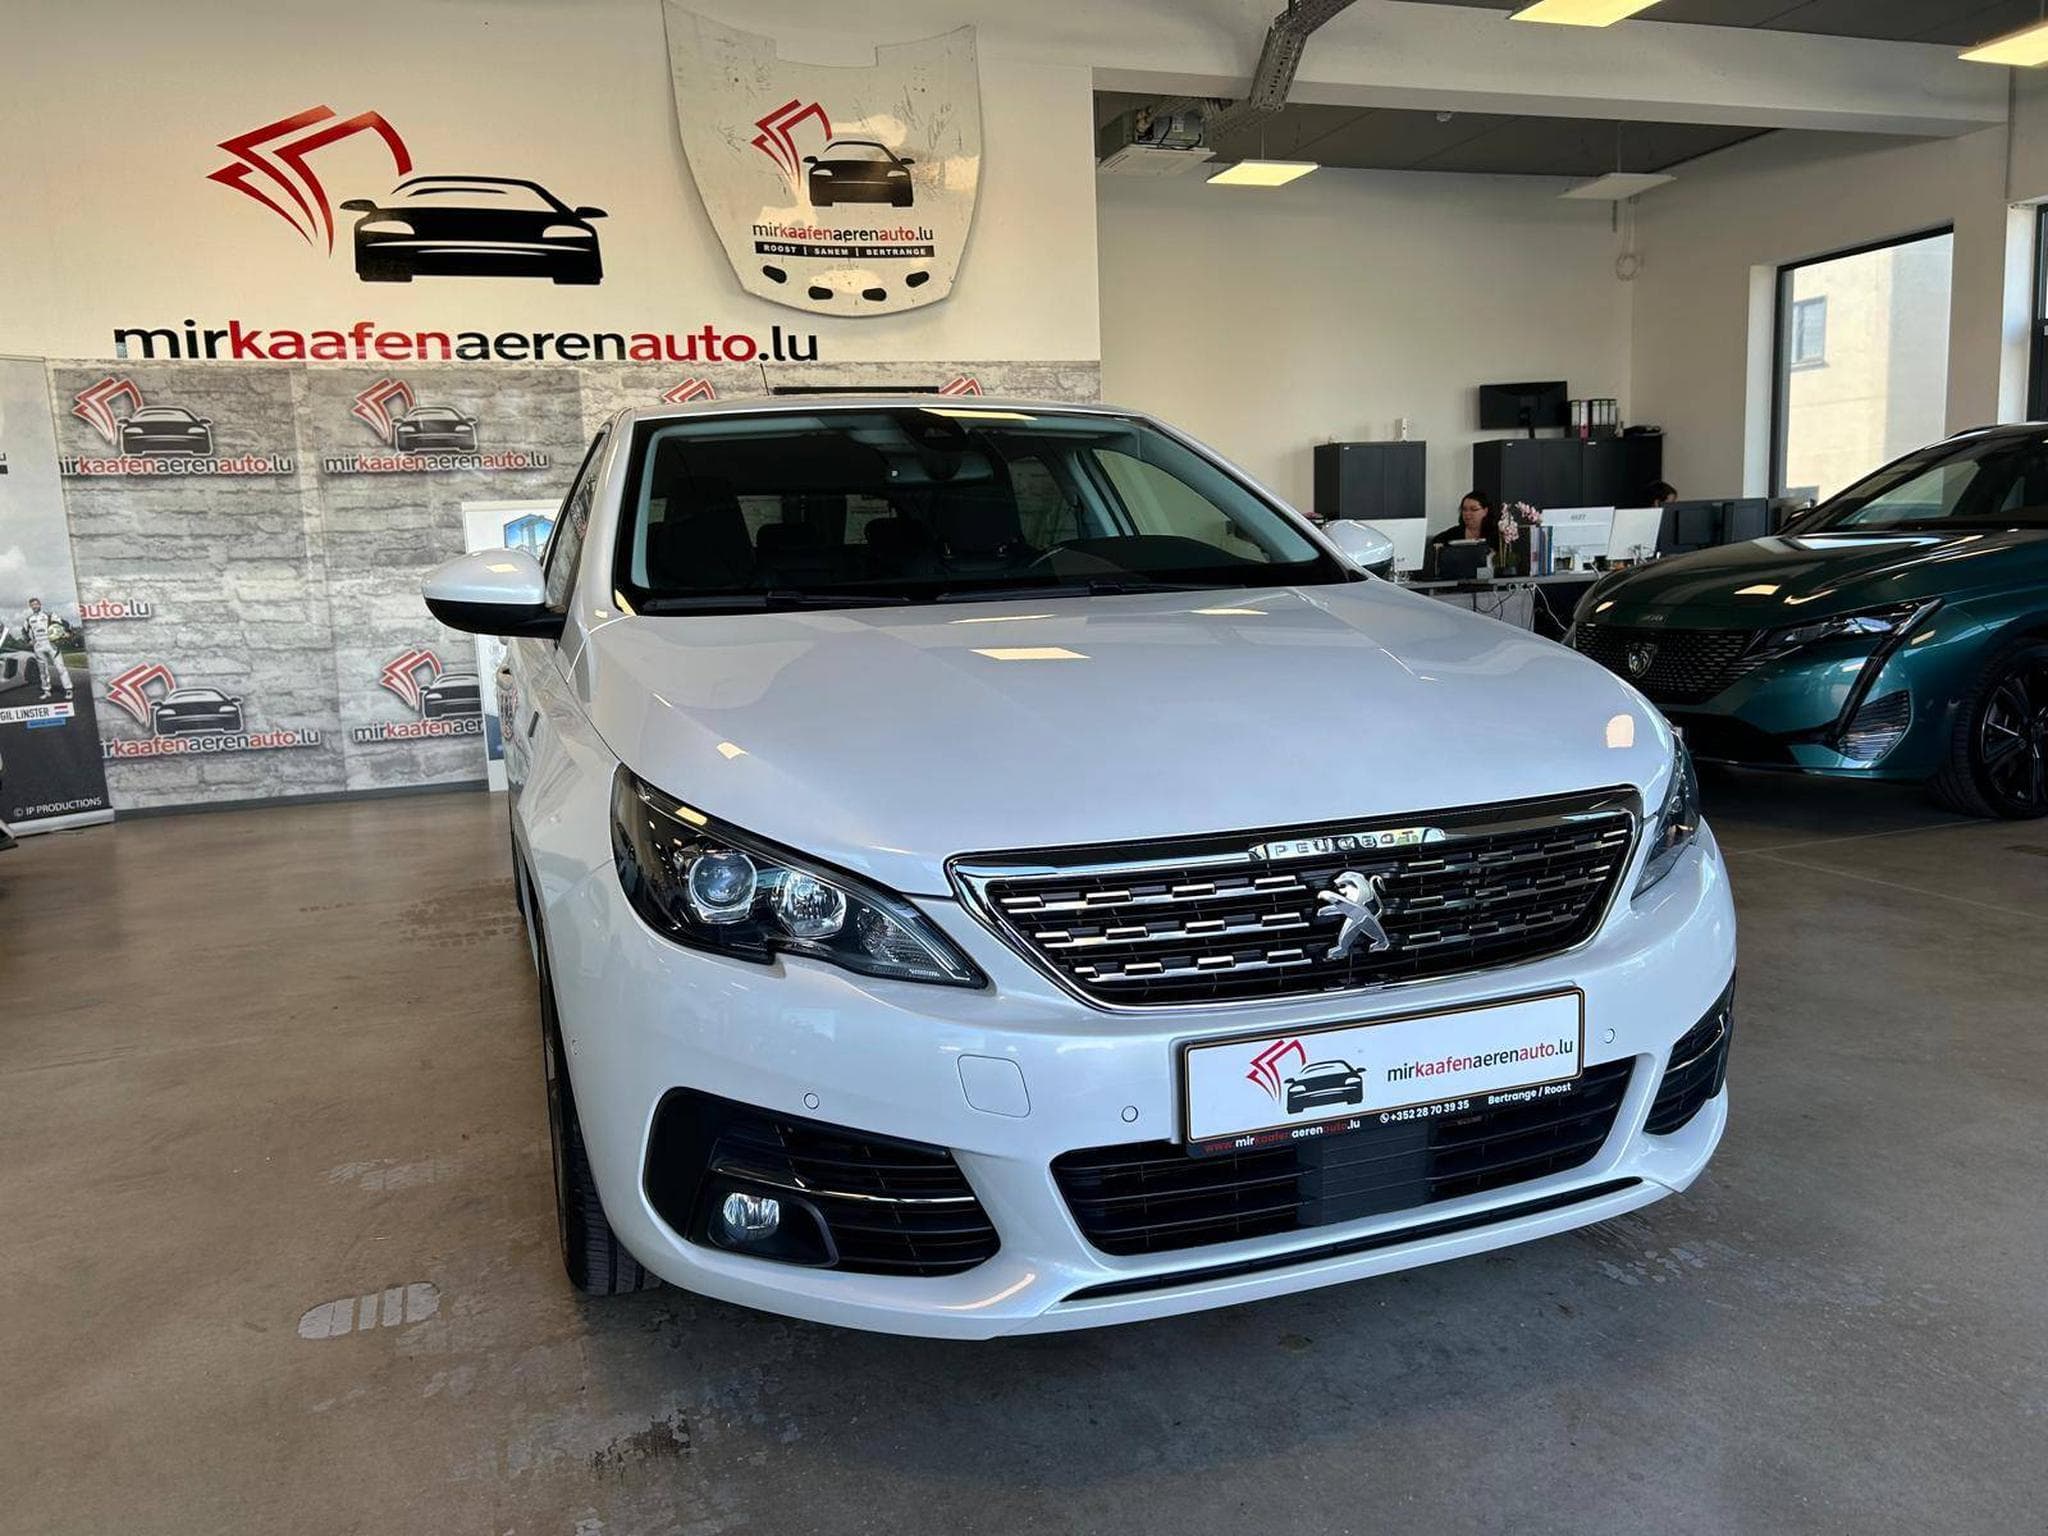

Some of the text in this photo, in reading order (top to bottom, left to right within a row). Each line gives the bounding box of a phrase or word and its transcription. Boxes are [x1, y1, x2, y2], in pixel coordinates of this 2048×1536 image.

[752, 222, 933, 243] mirkaafenaerenauto.lu
[763, 244, 926, 256] ROOST SANEM BERTRANGE
[113, 319, 818, 361] mirkaafenaerenauto.lu
[325, 451, 548, 472] mirkaafenaerenauto.lu
[80, 599, 149, 618] auto.lu
[36, 797, 102, 814] PRODUCTIONS
[1387, 1039, 1573, 1082] mirkaafenaerenauto.lu
[1488, 1089, 1537, 1105] Bertrange
[1544, 1082, 1571, 1096] Roost
[1390, 1099, 1470, 1121] +352 28 70 39 35
